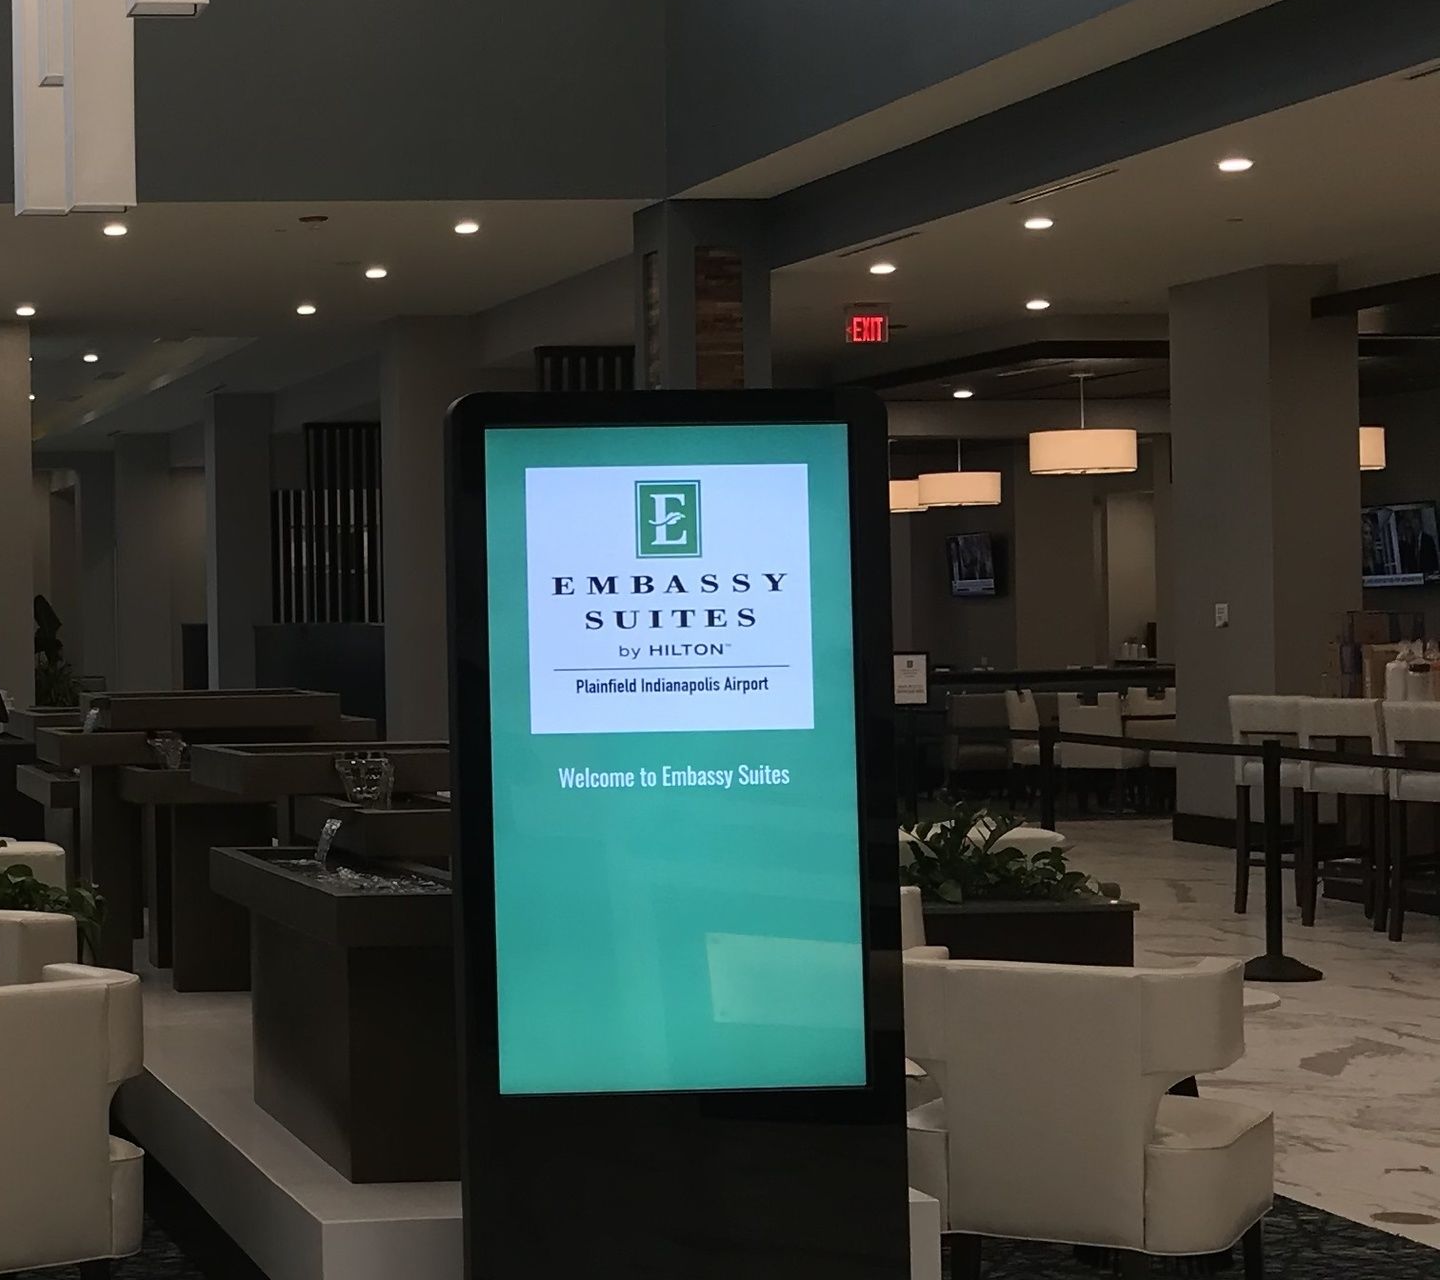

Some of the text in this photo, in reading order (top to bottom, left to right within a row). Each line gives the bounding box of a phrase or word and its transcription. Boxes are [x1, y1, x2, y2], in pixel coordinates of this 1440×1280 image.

[853, 317, 884, 342] EXIT
[551, 572, 788, 596] EMBASSY
[585, 607, 756, 630] SUITES
[618, 645, 641, 660] by
[576, 676, 769, 695] Plainfield Indianapolis Airport
[559, 764, 791, 790] Welcome to Embassy Suites
